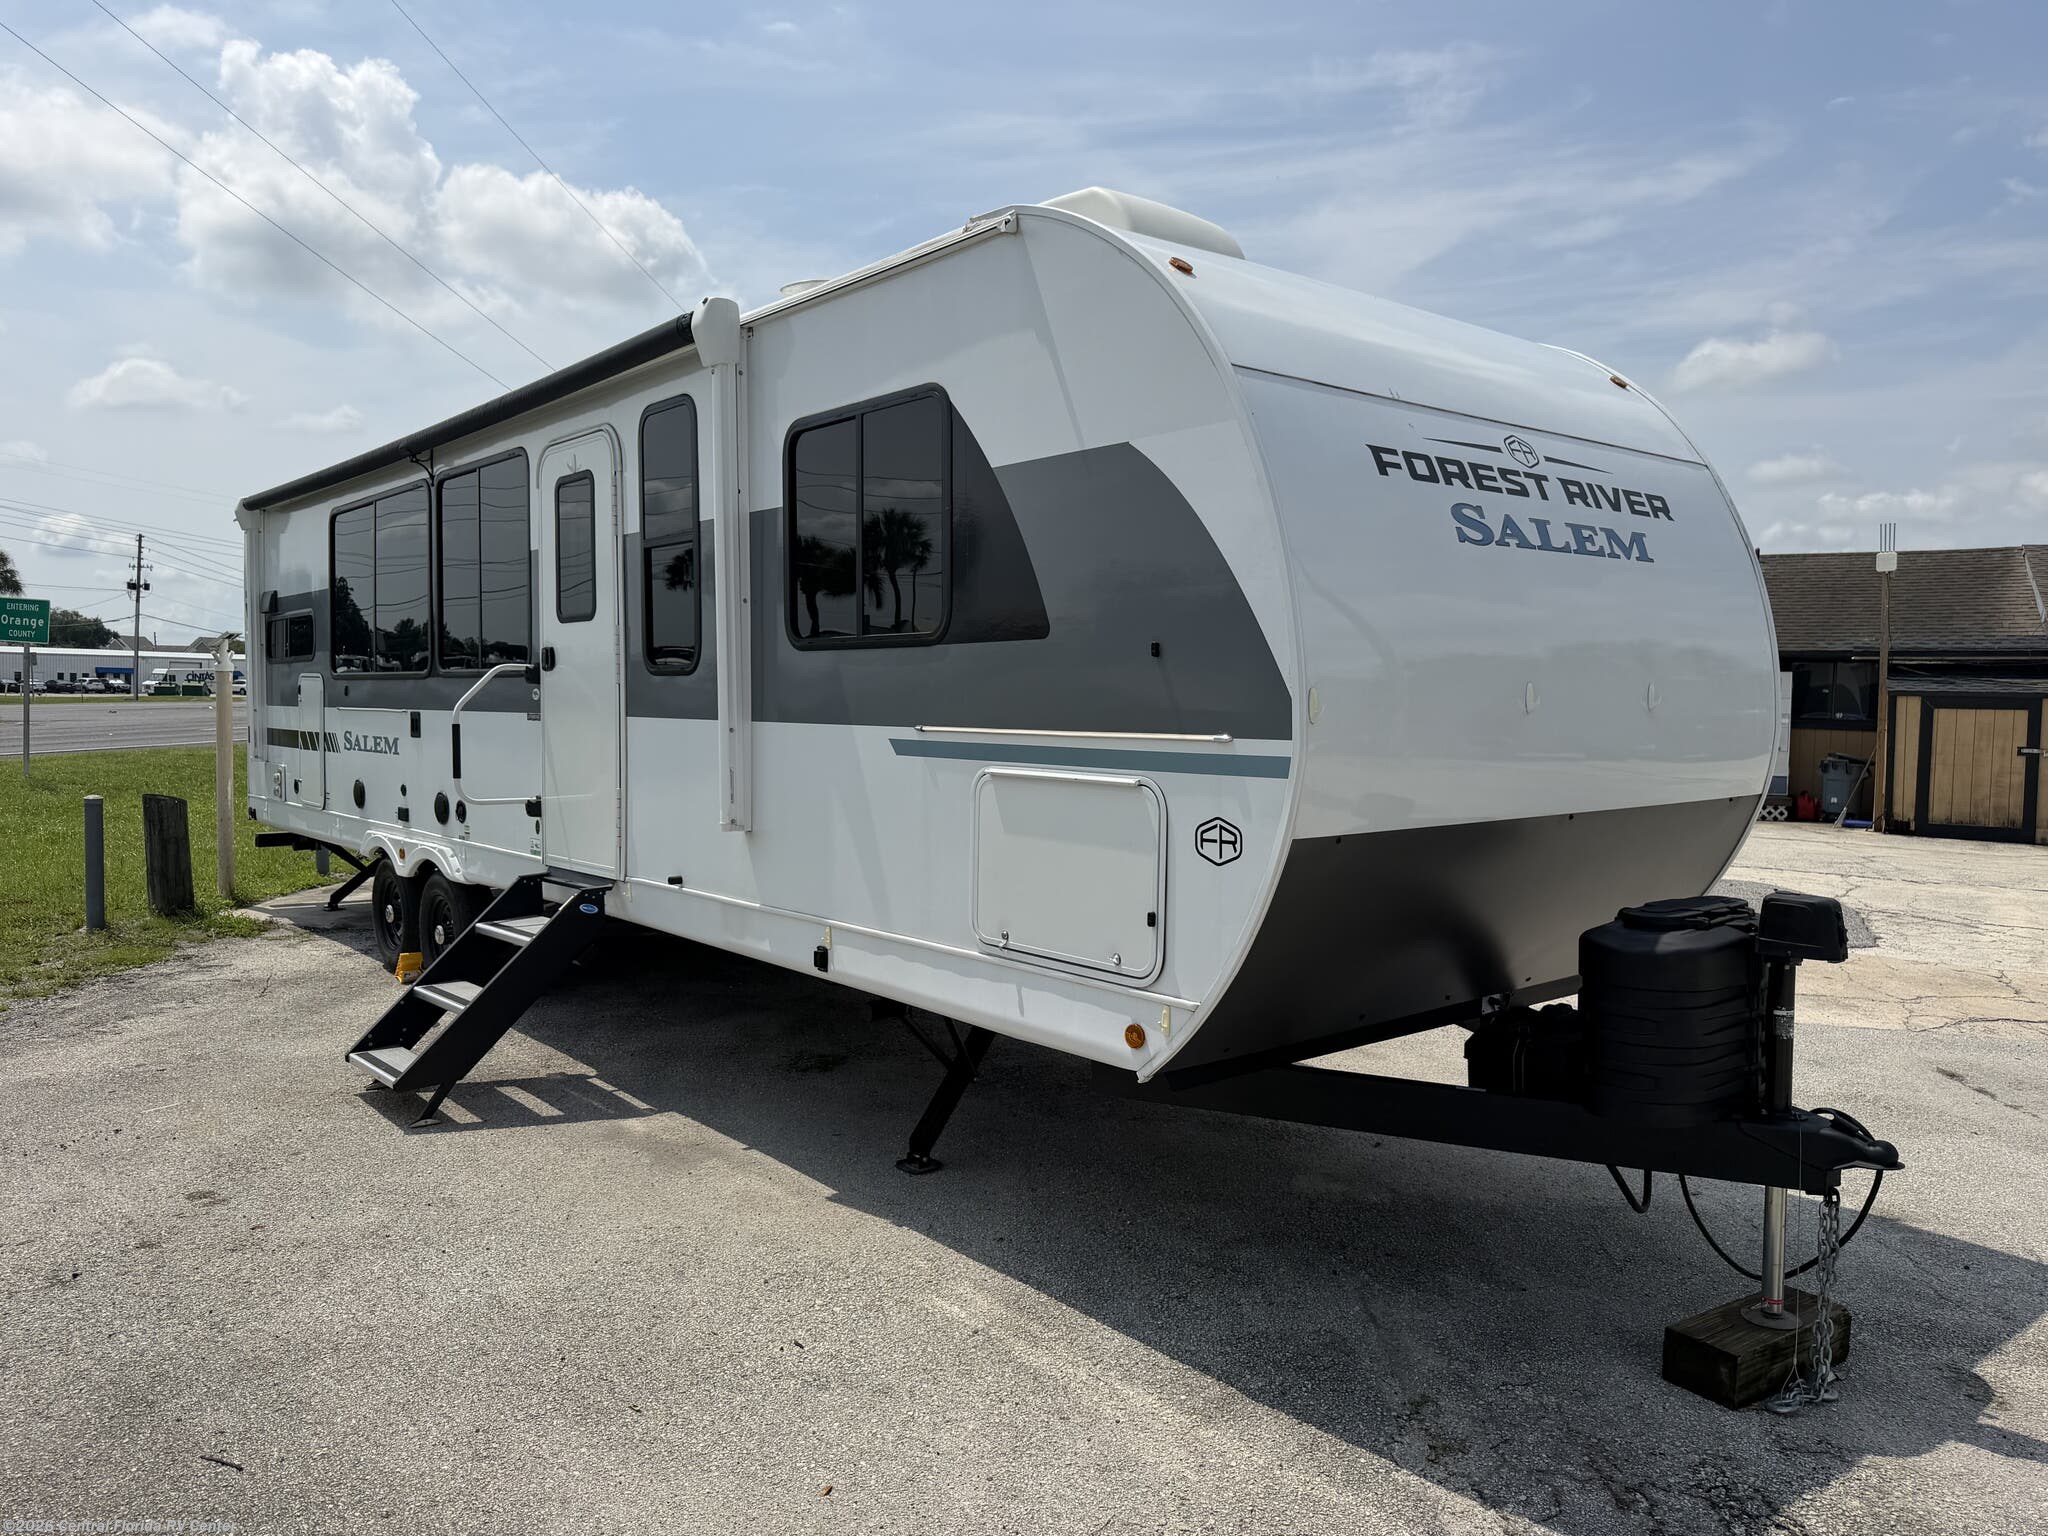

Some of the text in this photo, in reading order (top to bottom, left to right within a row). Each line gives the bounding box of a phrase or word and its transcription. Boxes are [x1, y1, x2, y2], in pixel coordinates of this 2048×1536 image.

[1365, 443, 1675, 522] FOREST RIVER
[1450, 502, 1654, 563] SALEM
[6, 602, 39, 611] ENTERING
[1, 614, 44, 629] Orange
[8, 629, 36, 638] COUNTY
[343, 730, 400, 756] SALEM
